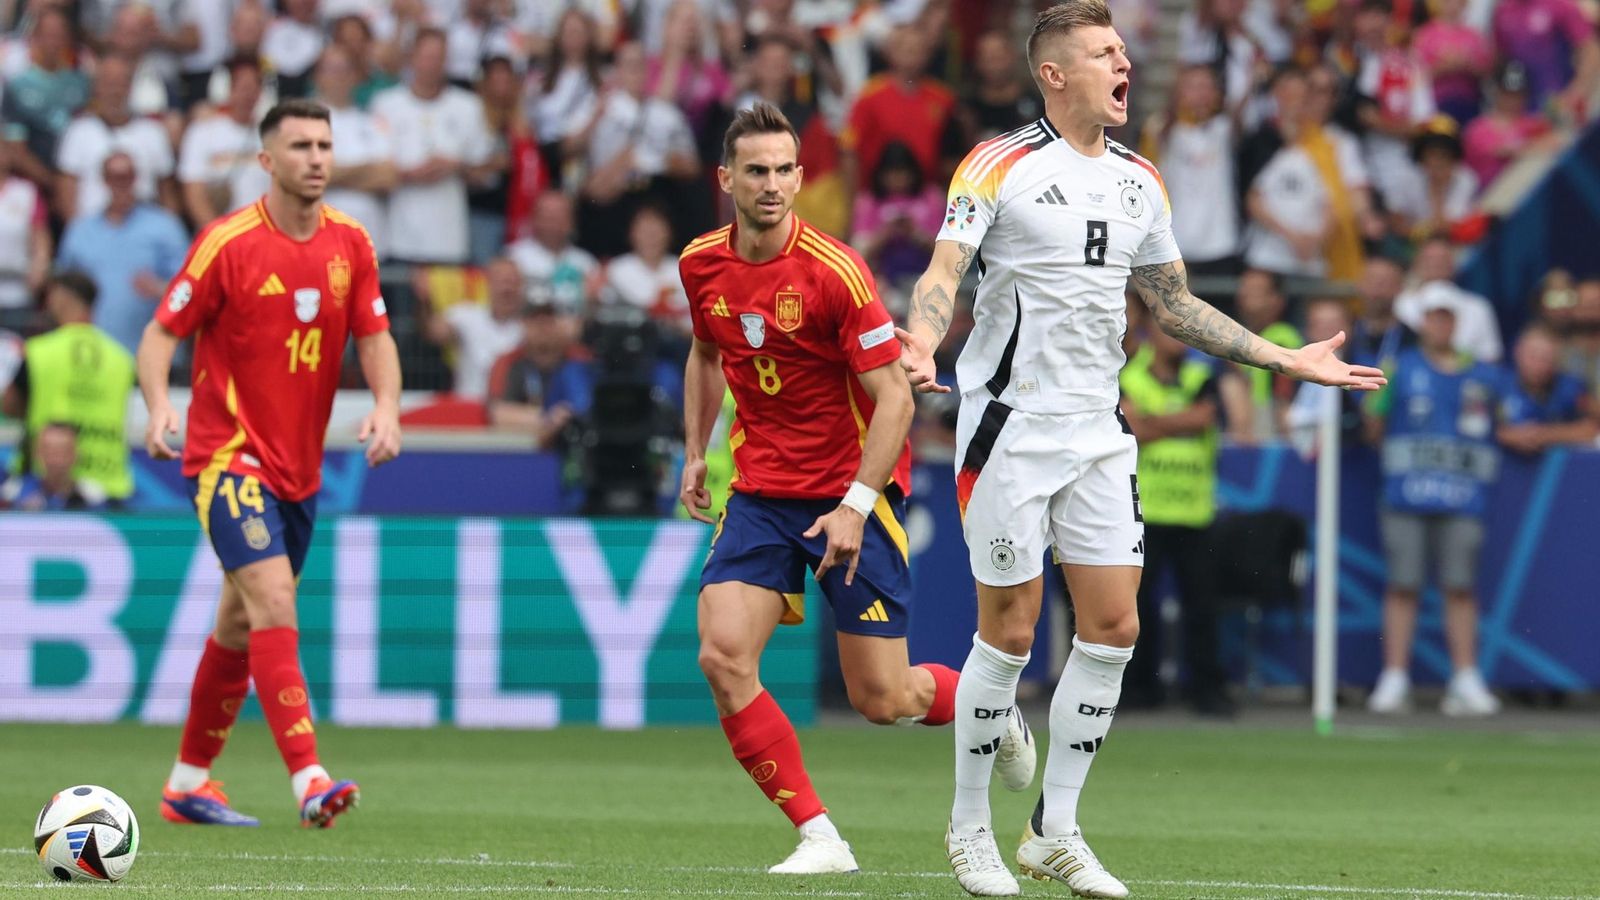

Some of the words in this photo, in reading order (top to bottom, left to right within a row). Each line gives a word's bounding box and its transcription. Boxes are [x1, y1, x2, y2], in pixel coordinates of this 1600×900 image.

[1084, 220, 1108, 266] 8
[285, 328, 322, 374] 14
[753, 356, 782, 395] 8
[218, 474, 265, 519] 14
